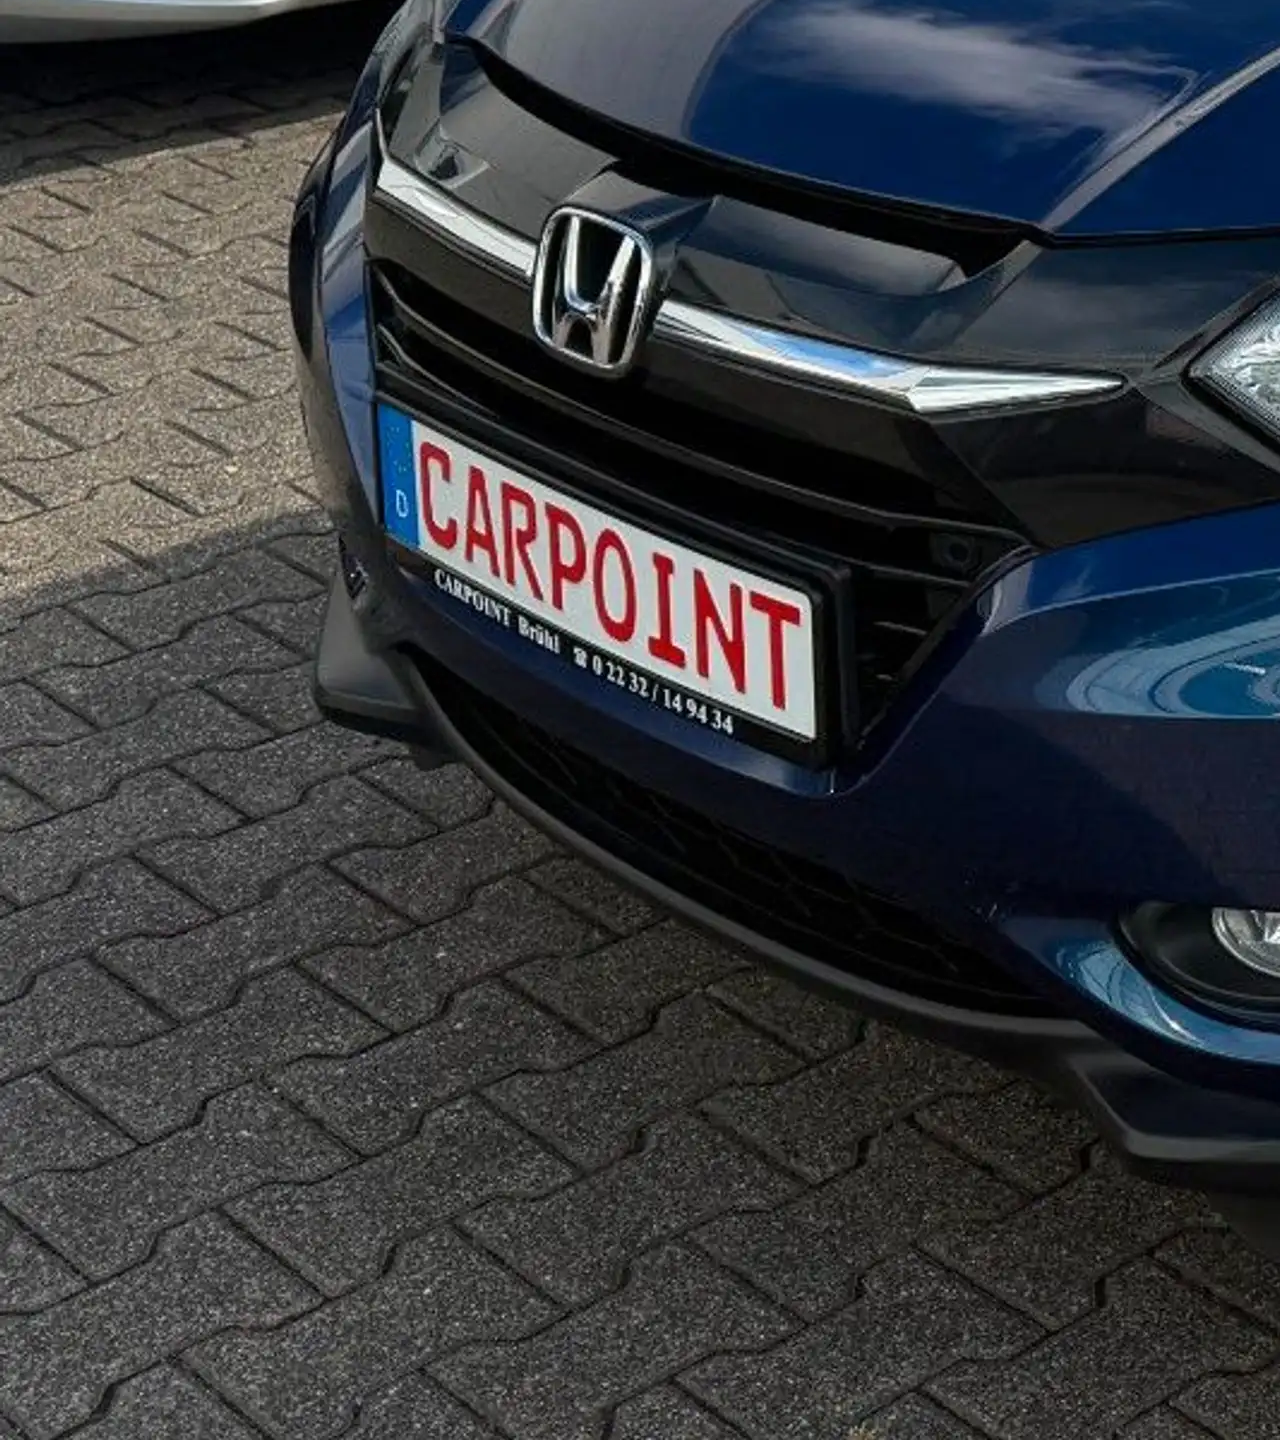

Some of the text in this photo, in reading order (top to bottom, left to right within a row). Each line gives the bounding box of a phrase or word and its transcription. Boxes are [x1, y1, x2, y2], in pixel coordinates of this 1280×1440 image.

[395, 489, 409, 518] D
[419, 440, 803, 712] CARPOINT
[434, 568, 734, 736] CARPOINT Brühl 0 22 32 / 14 94 34
